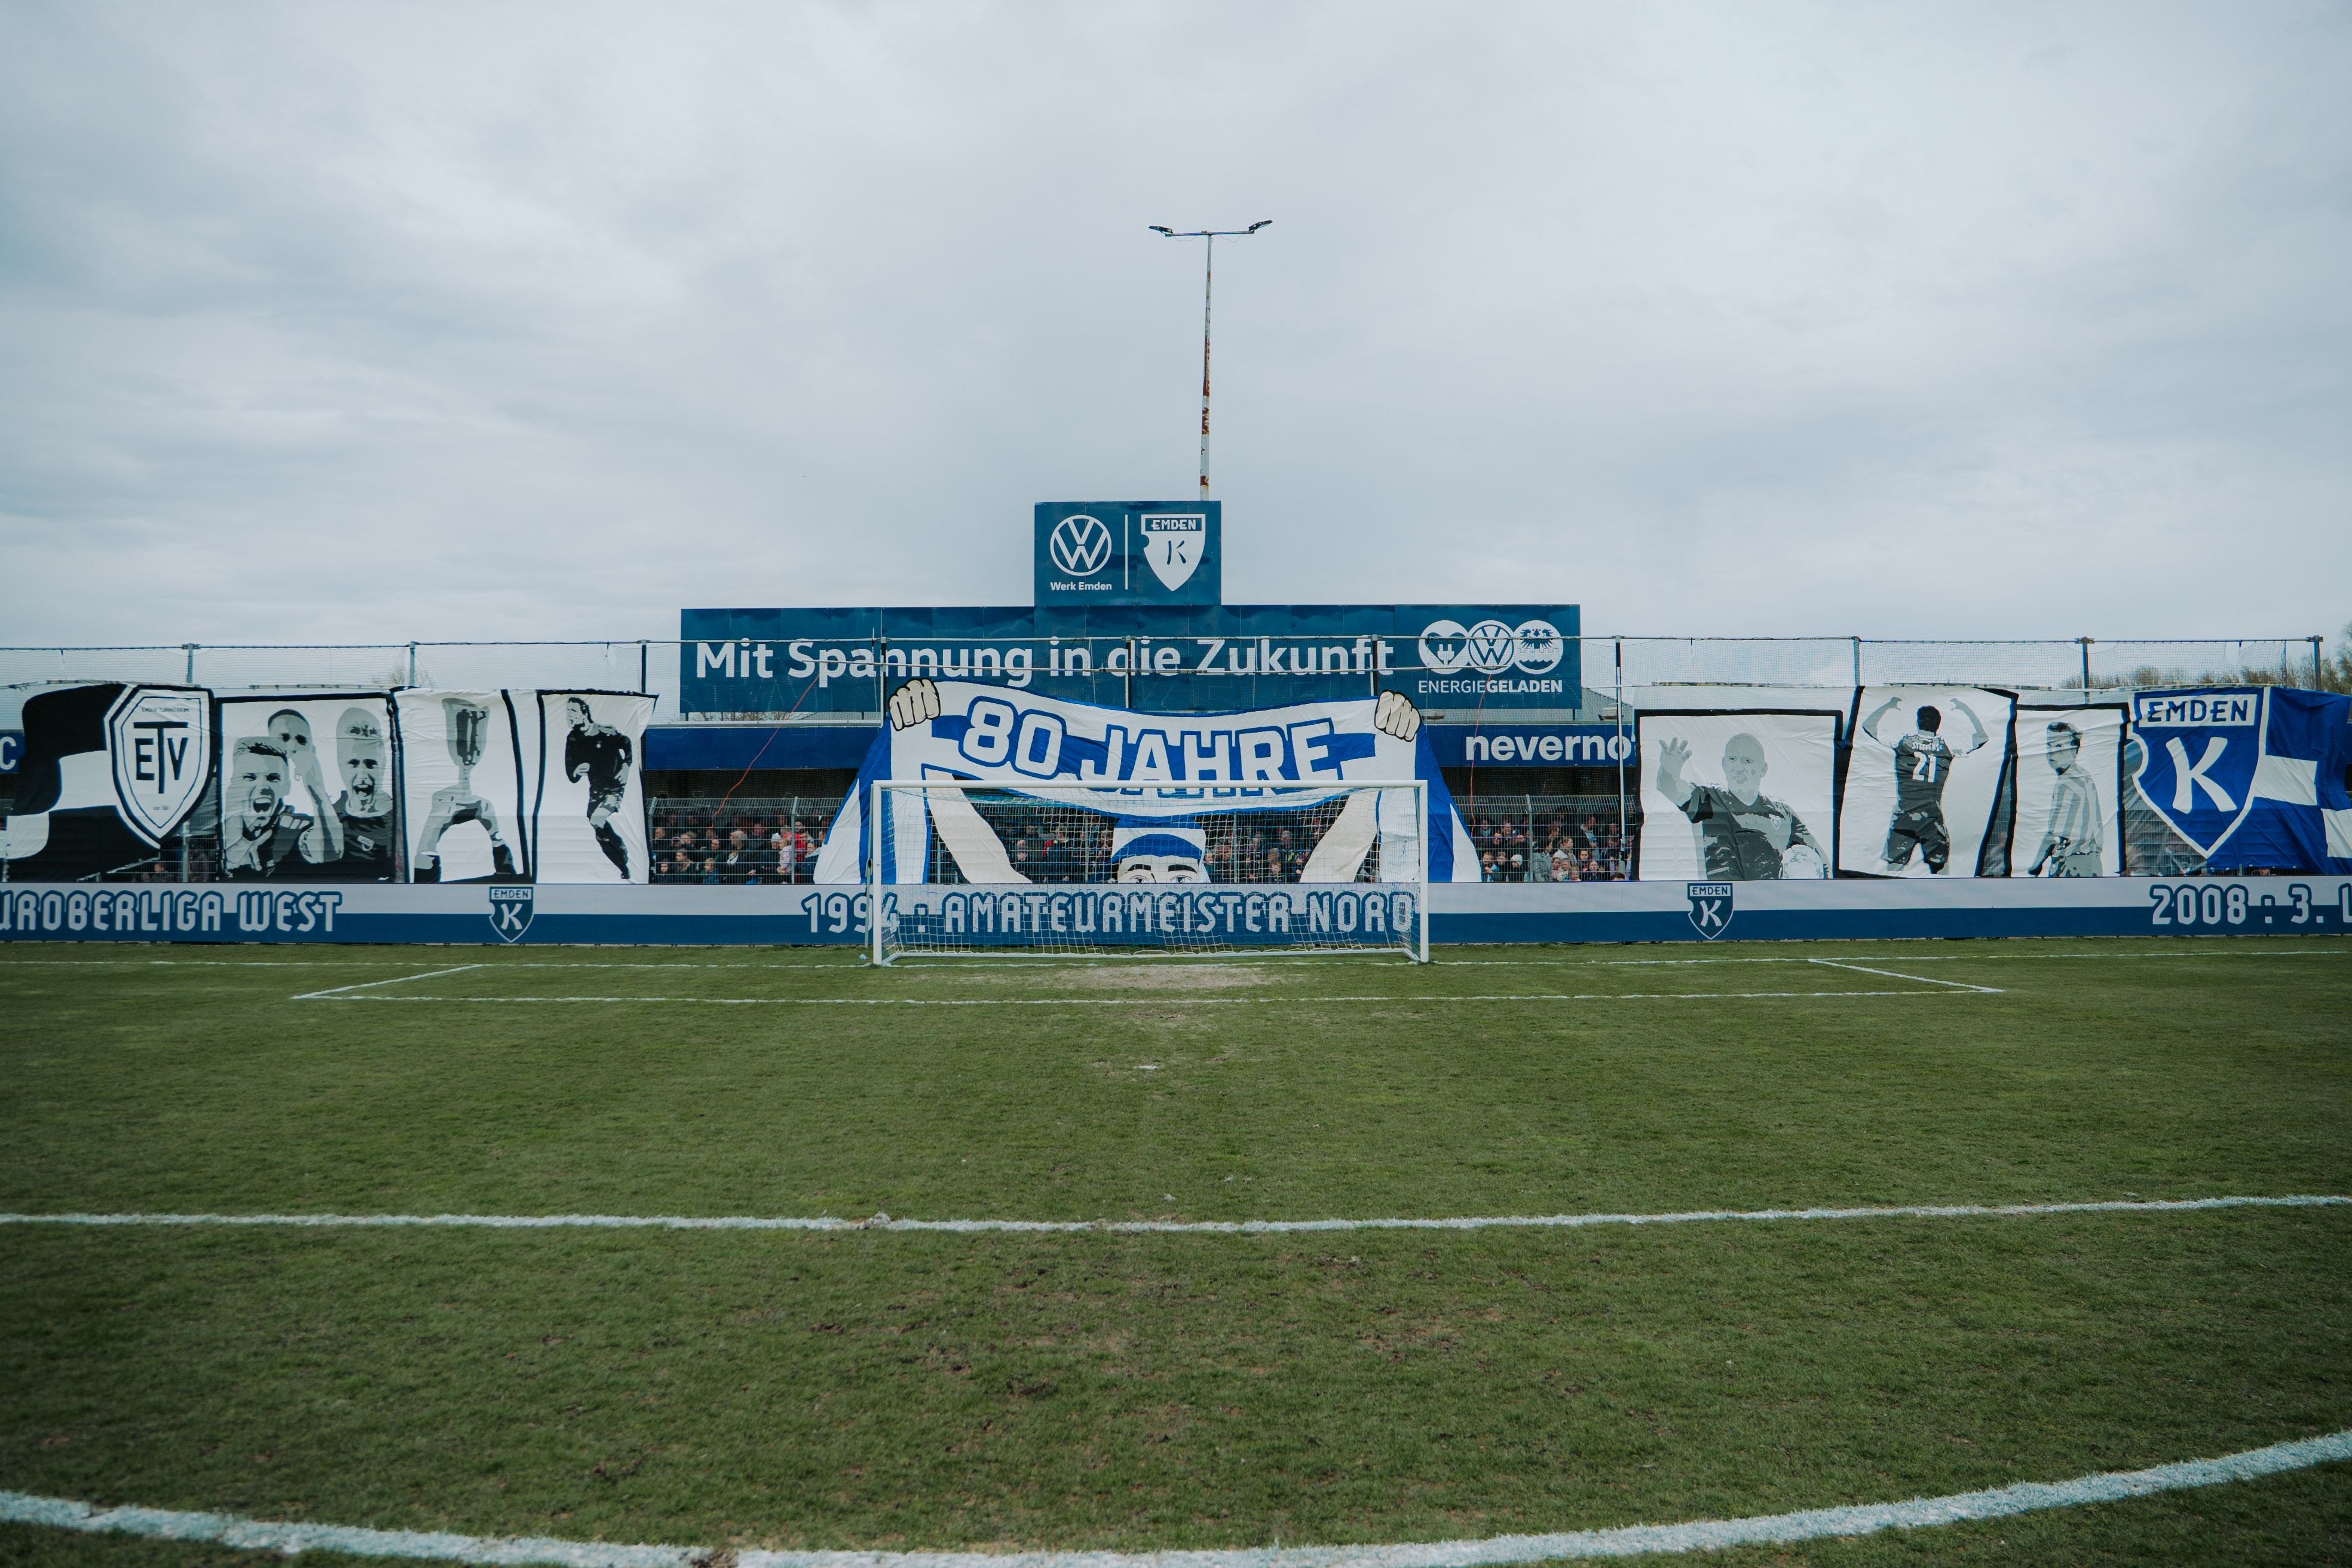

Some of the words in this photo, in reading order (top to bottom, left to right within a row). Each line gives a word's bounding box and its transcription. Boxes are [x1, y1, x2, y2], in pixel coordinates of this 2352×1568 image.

[1151, 519, 1196, 531] EMDEN
[1166, 540, 1187, 565] K
[1050, 582, 1076, 590] Werk
[1078, 582, 1112, 590] Emden
[697, 638, 774, 678] Mit
[788, 638, 1033, 688] Spannung
[1050, 636, 1091, 676] in
[1107, 636, 1181, 676] die
[1196, 638, 1394, 675] Zukunft
[1419, 679, 1563, 693] ENERGIEGELADEN
[2148, 700, 2247, 722] EMDEN
[963, 701, 1062, 776] 80
[1080, 723, 1341, 793] JAHRE
[1466, 736, 1636, 761] neverno
[1912, 751, 1937, 783] 21
[2166, 736, 2237, 814] K
[494, 890, 528, 898] EMDEN
[1692, 886, 1728, 895] EMDEN
[240, 894, 340, 932] WEST
[501, 903, 523, 930] K
[804, 895, 900, 933] 1994
[945, 895, 1289, 933] AMATEURMEISTER
[1309, 895, 1413, 932] NORD
[1699, 899, 1722, 927] K
[2152, 887, 2246, 925] 2008
[2290, 887, 2324, 924] 3.
